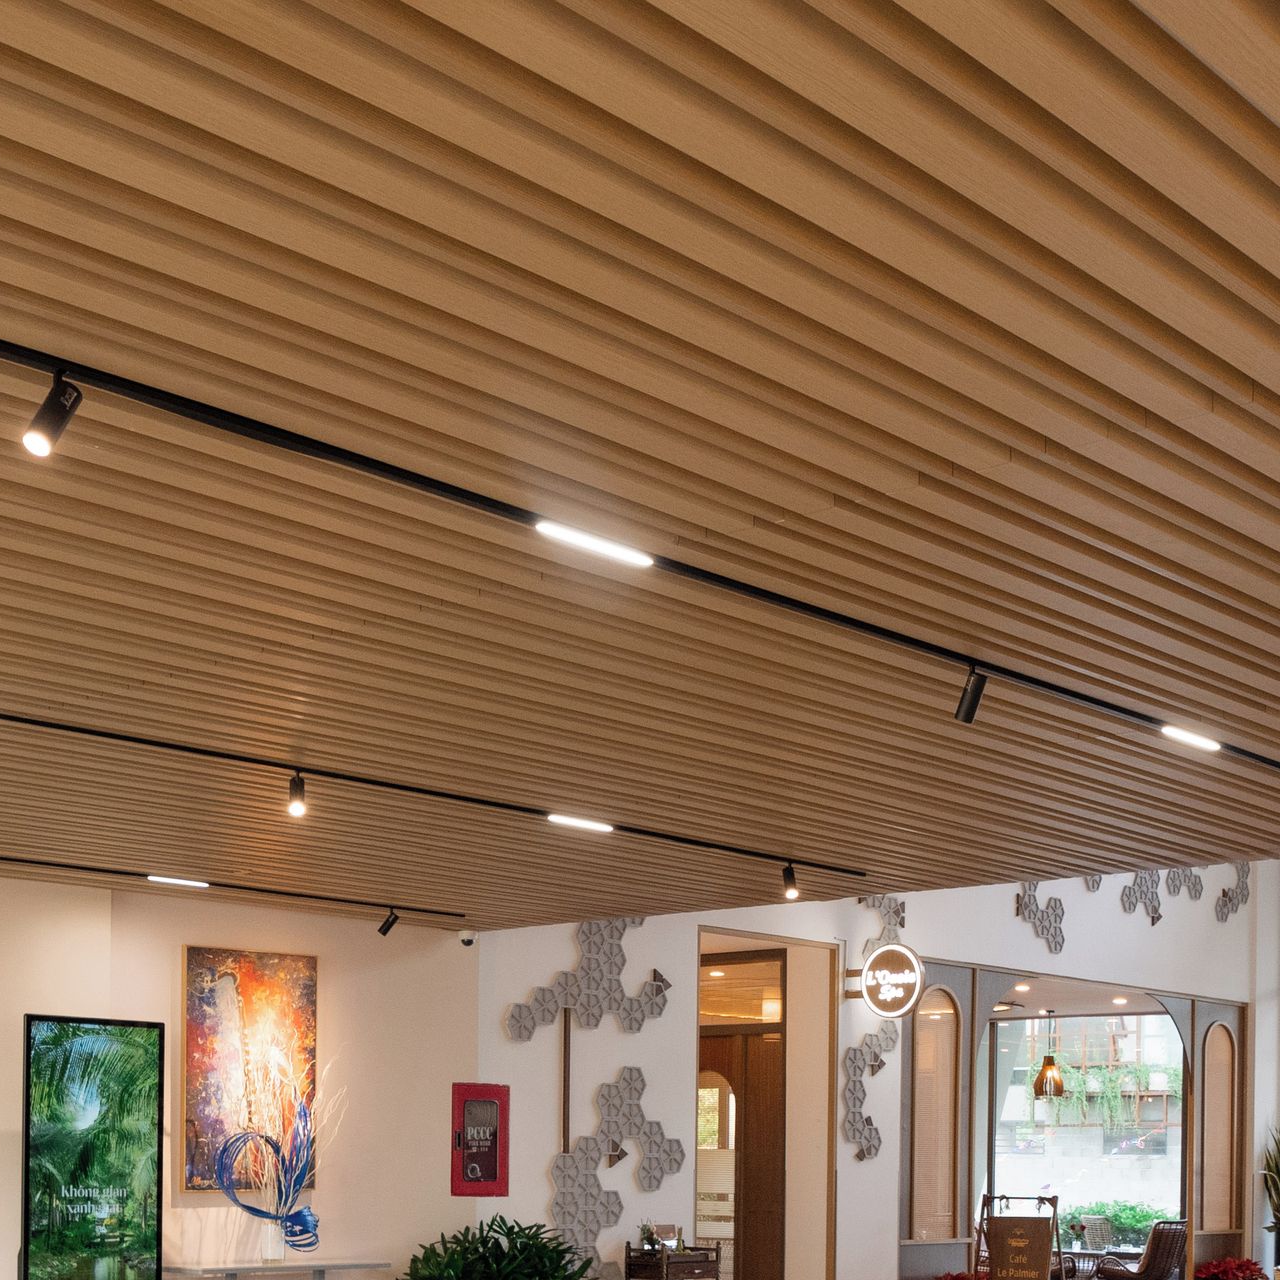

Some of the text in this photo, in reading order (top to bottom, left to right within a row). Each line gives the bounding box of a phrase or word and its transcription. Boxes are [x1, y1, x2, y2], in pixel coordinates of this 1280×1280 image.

[878, 984, 904, 1001] Spa
[467, 1126, 493, 1140] PCCC
[67, 1201, 95, 1214] xanh
[997, 1267, 1040, 1279] Le Palmier
